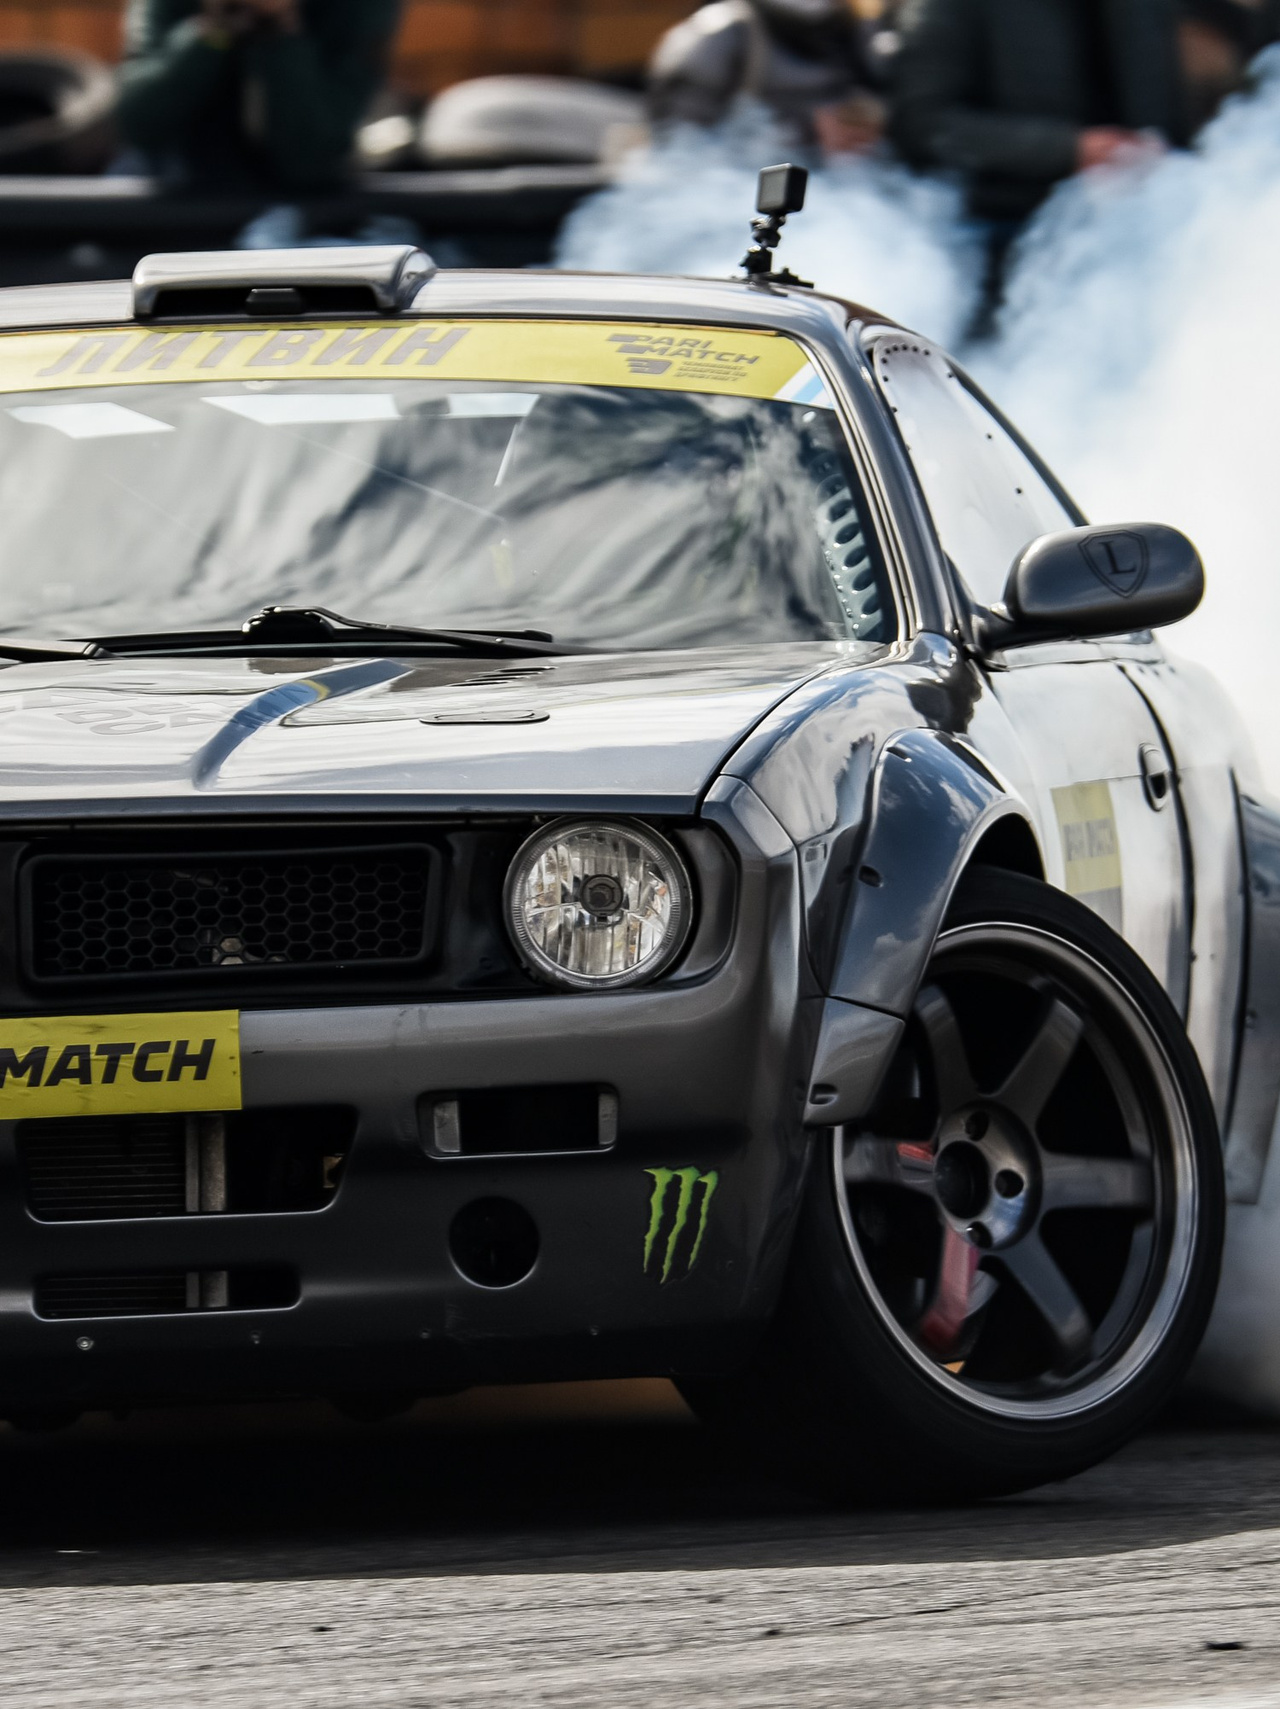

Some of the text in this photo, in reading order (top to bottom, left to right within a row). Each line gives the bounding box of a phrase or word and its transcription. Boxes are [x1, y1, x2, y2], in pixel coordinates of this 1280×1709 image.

[36, 327, 471, 377] ЛИТВИН
[618, 344, 760, 364] MATCH
[1099, 540, 1137, 575] L
[0, 1039, 216, 1089] MATCH
